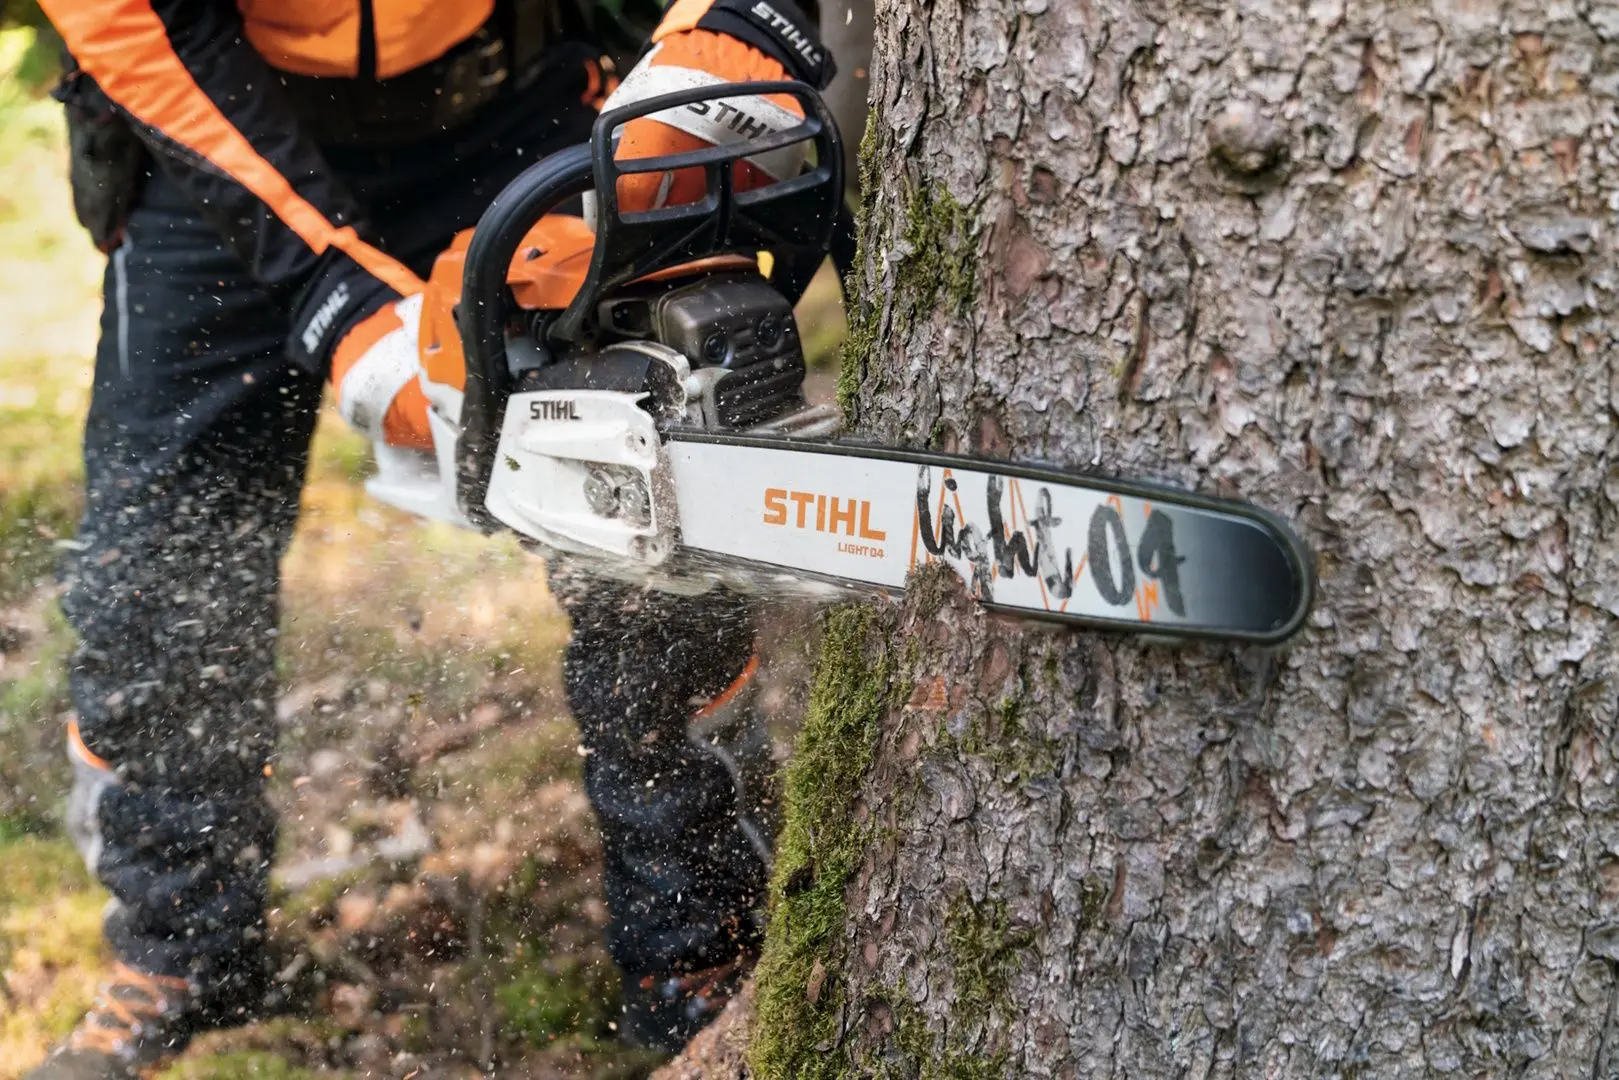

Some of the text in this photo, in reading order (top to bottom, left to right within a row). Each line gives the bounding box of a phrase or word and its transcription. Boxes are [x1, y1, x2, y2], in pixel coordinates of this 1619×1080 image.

[751, 1, 821, 66] STIHL
[687, 101, 776, 140] STIH
[302, 282, 349, 354] STIHL
[530, 400, 581, 420] STIHL
[764, 487, 886, 541] STIHL
